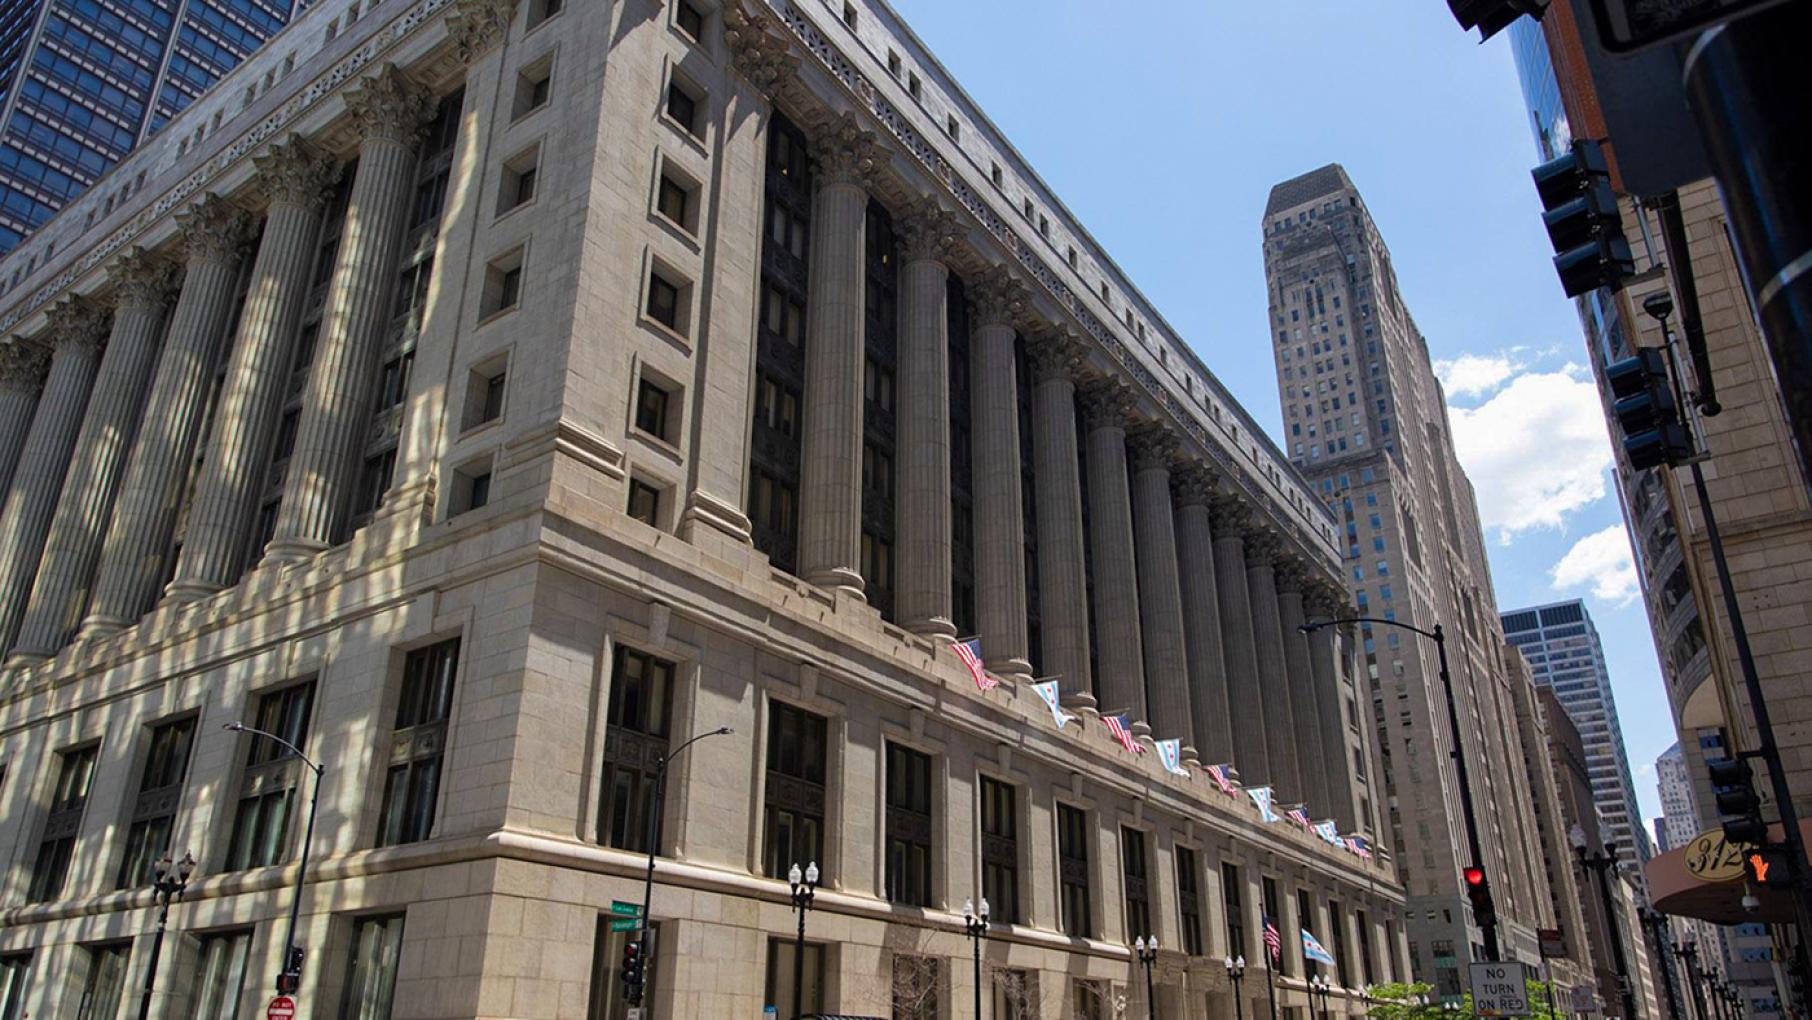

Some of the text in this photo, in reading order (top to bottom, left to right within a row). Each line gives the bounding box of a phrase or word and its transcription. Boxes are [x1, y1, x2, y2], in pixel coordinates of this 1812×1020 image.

[1486, 968, 1506, 980] NO
[1482, 984, 1515, 995] TURN
[1478, 999, 1524, 1011] ON RED
